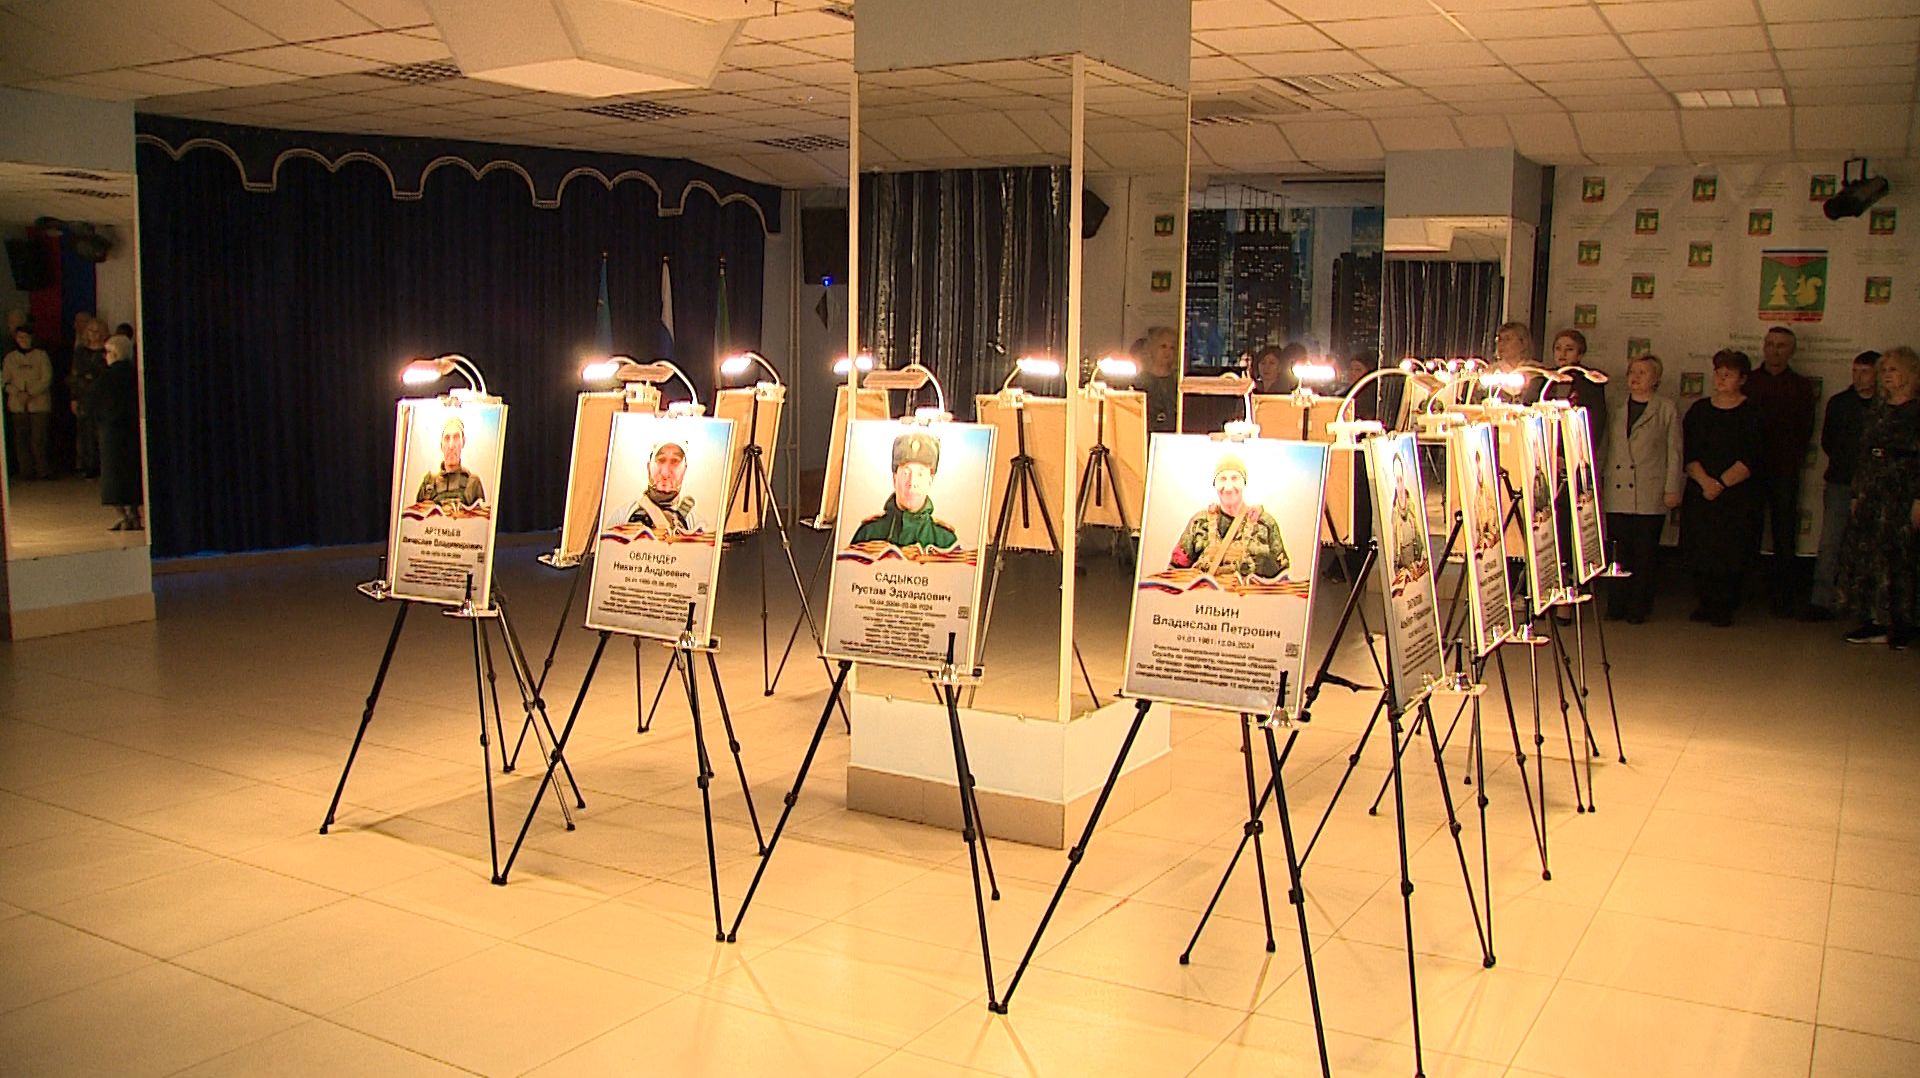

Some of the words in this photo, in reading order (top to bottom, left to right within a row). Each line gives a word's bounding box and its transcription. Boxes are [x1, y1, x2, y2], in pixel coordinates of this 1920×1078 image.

[613, 561, 643, 573] Никита
[874, 572, 929, 587] САДЫКОВ
[851, 582, 887, 597] Рустам
[888, 586, 952, 603] Эдуардович
[1195, 604, 1240, 619] ИЛЬИН
[1152, 614, 1218, 631] Владислав
[1220, 622, 1281, 639] Петрович
